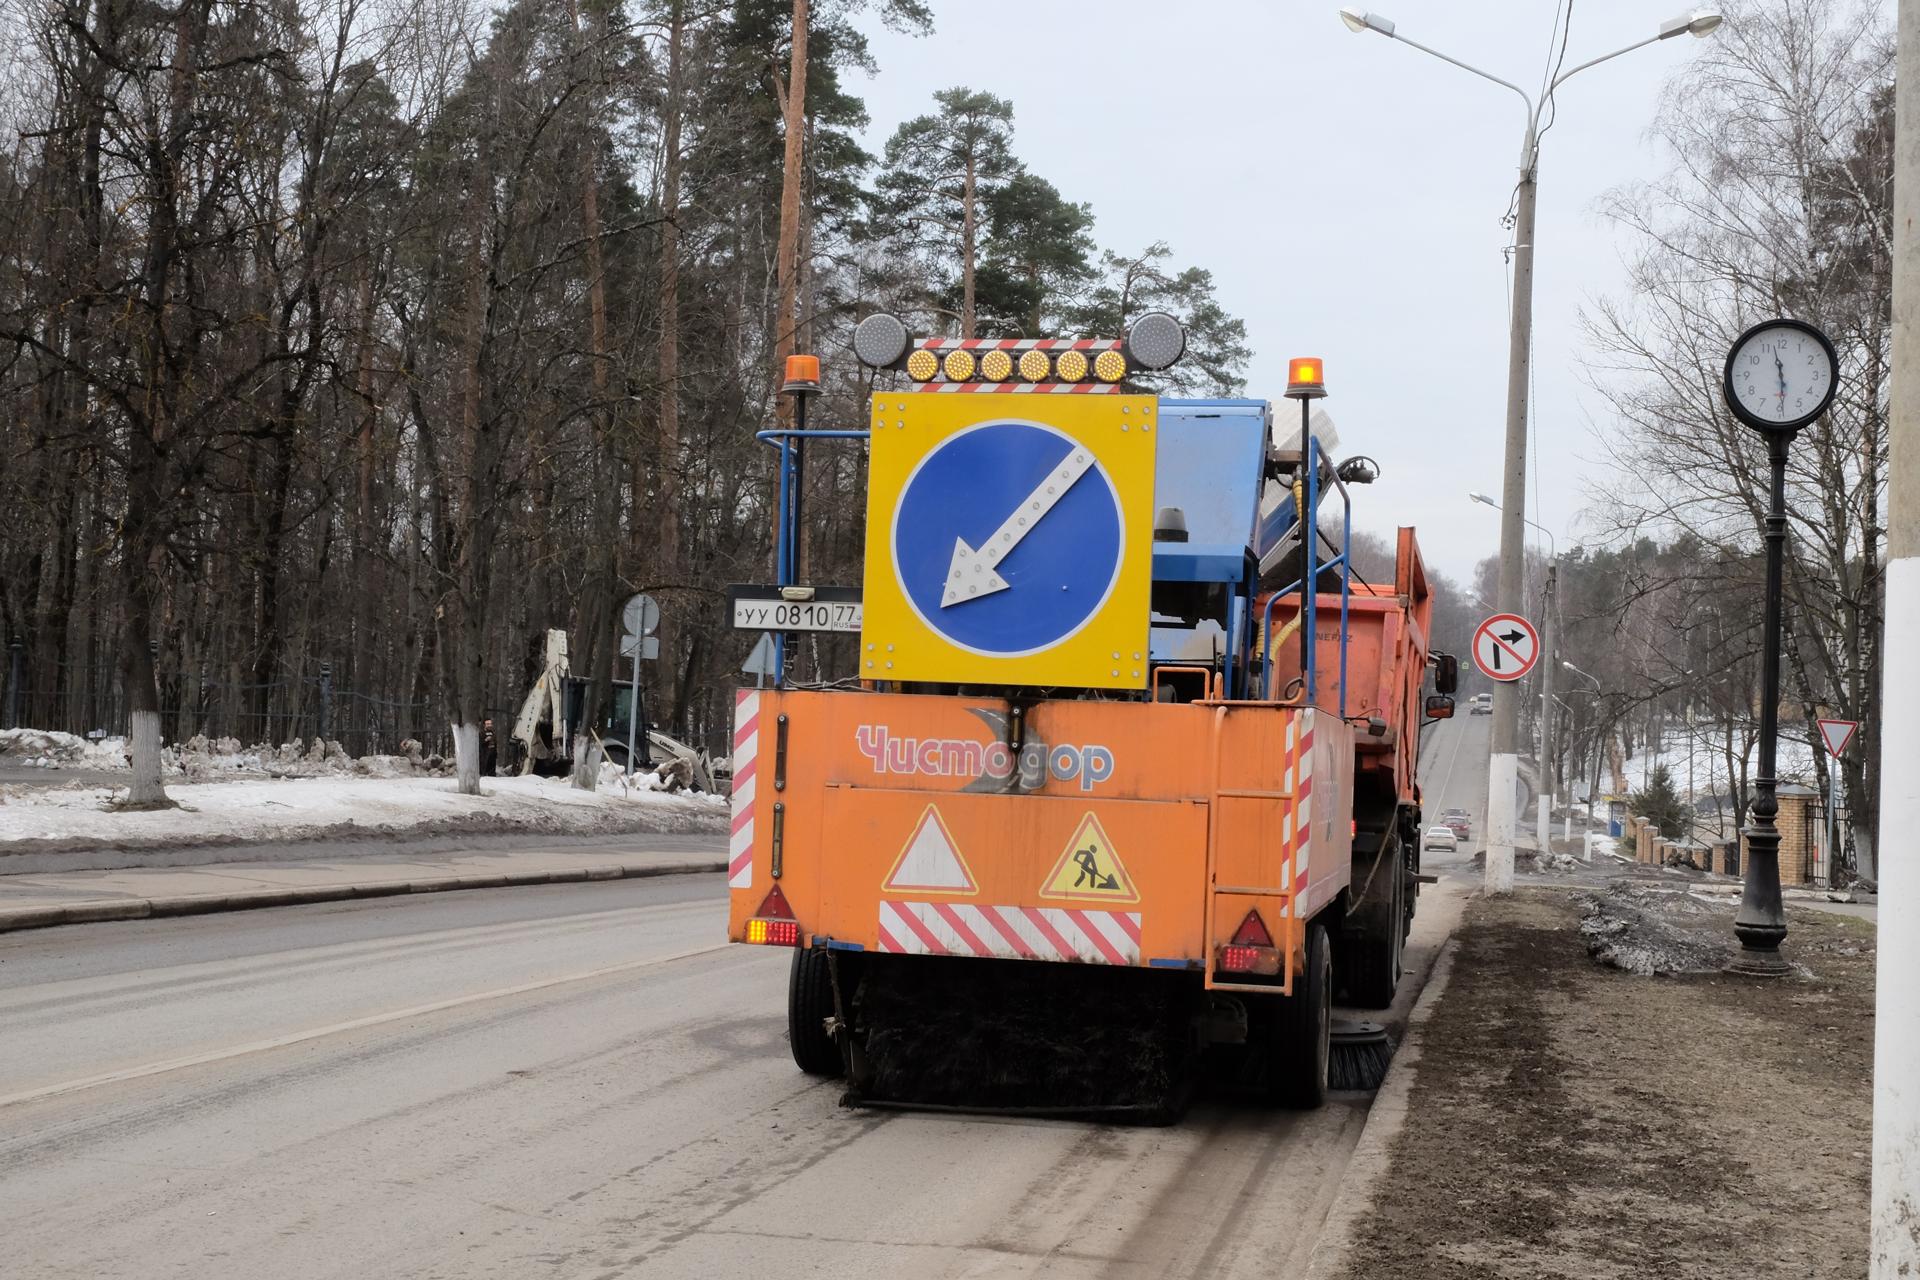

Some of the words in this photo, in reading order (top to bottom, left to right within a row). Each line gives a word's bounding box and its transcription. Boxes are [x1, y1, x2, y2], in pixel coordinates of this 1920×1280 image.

[1761, 343, 1770, 353] 11
[1777, 339, 1788, 349] 12
[1749, 355, 1760, 366] 10
[1807, 354, 1815, 366] 2
[1743, 370, 1751, 381] 9
[1812, 370, 1819, 381] 3
[1748, 385, 1755, 395] 8
[1806, 385, 1813, 394] 4
[1759, 397, 1767, 407] 7
[1795, 398, 1802, 408] 5
[775, 604, 829, 627] 0810
[835, 605, 856, 621] 77
[856, 725, 1115, 791] Чистодор
